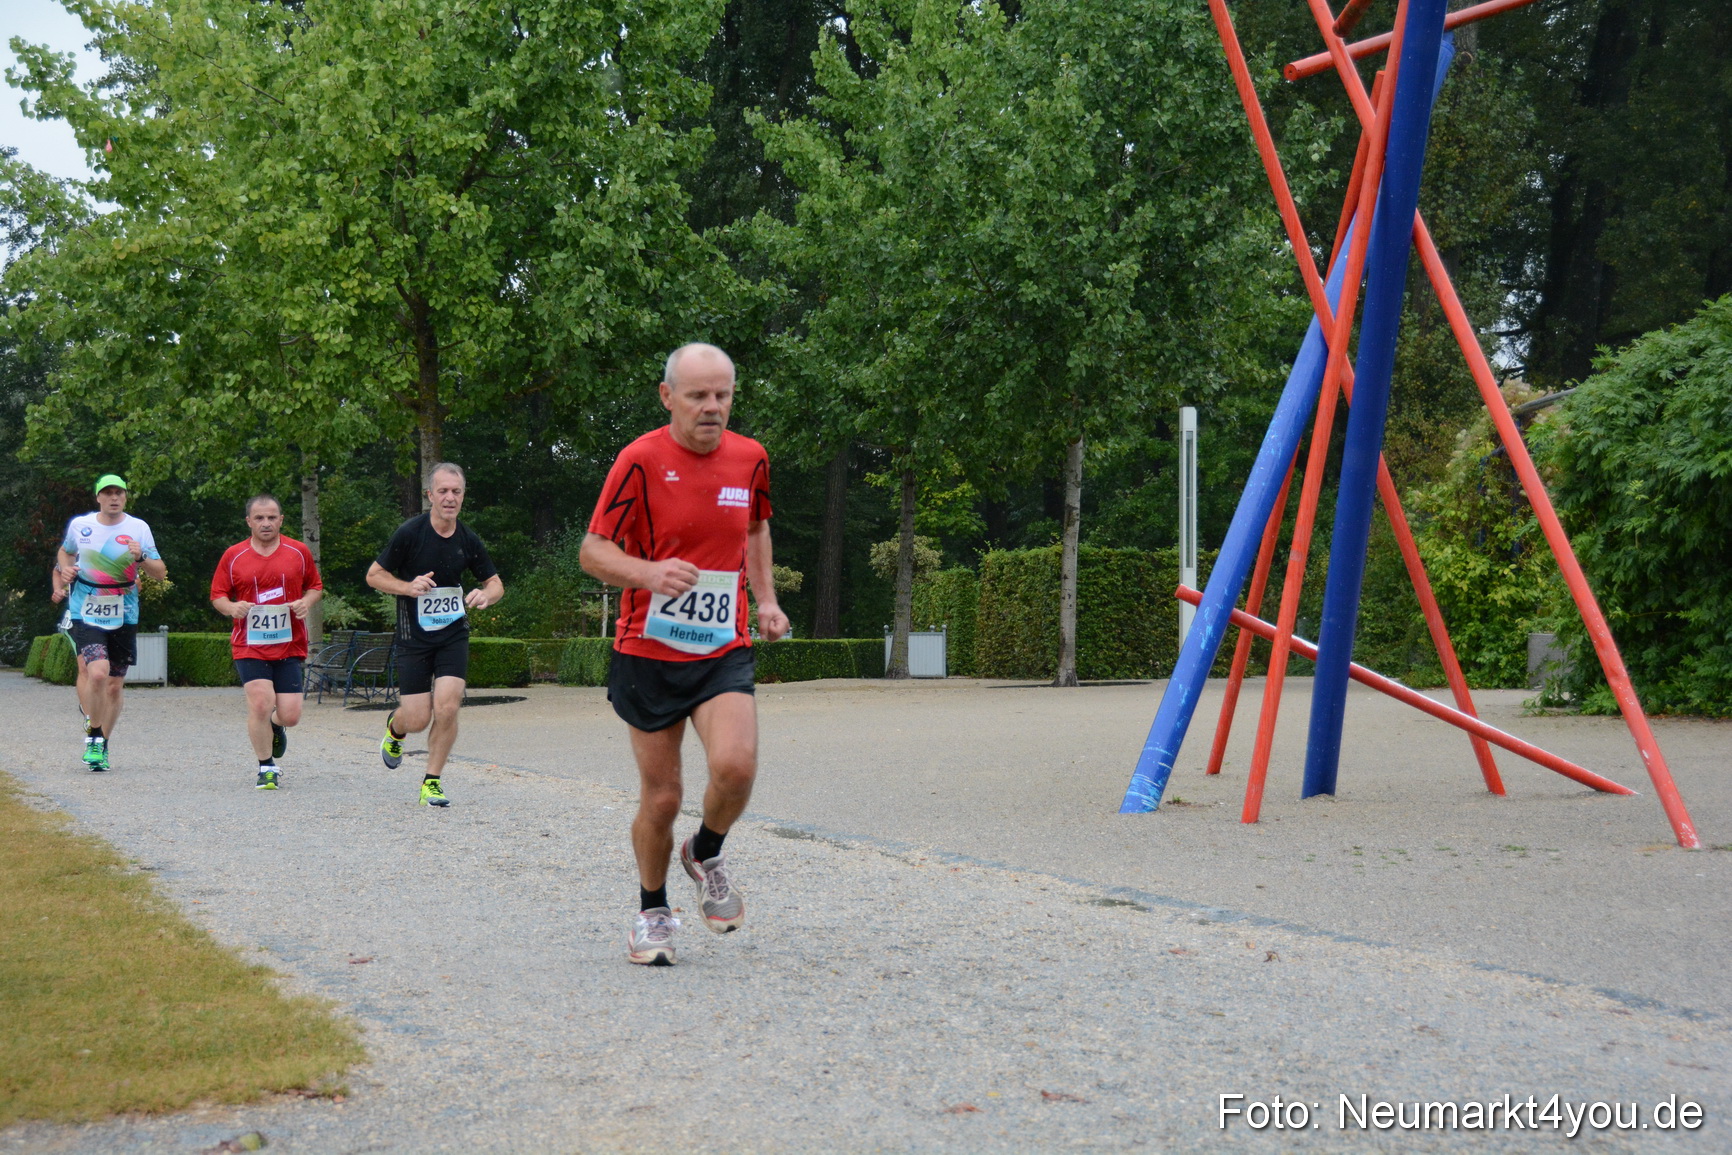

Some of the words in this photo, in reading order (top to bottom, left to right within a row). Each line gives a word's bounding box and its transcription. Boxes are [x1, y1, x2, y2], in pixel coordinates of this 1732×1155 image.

[717, 487, 749, 502] JURA
[86, 602, 119, 616] 2451
[423, 596, 459, 614] 2236
[660, 591, 730, 624] 2438
[252, 612, 287, 629] 2417
[669, 626, 714, 643] Herbert
